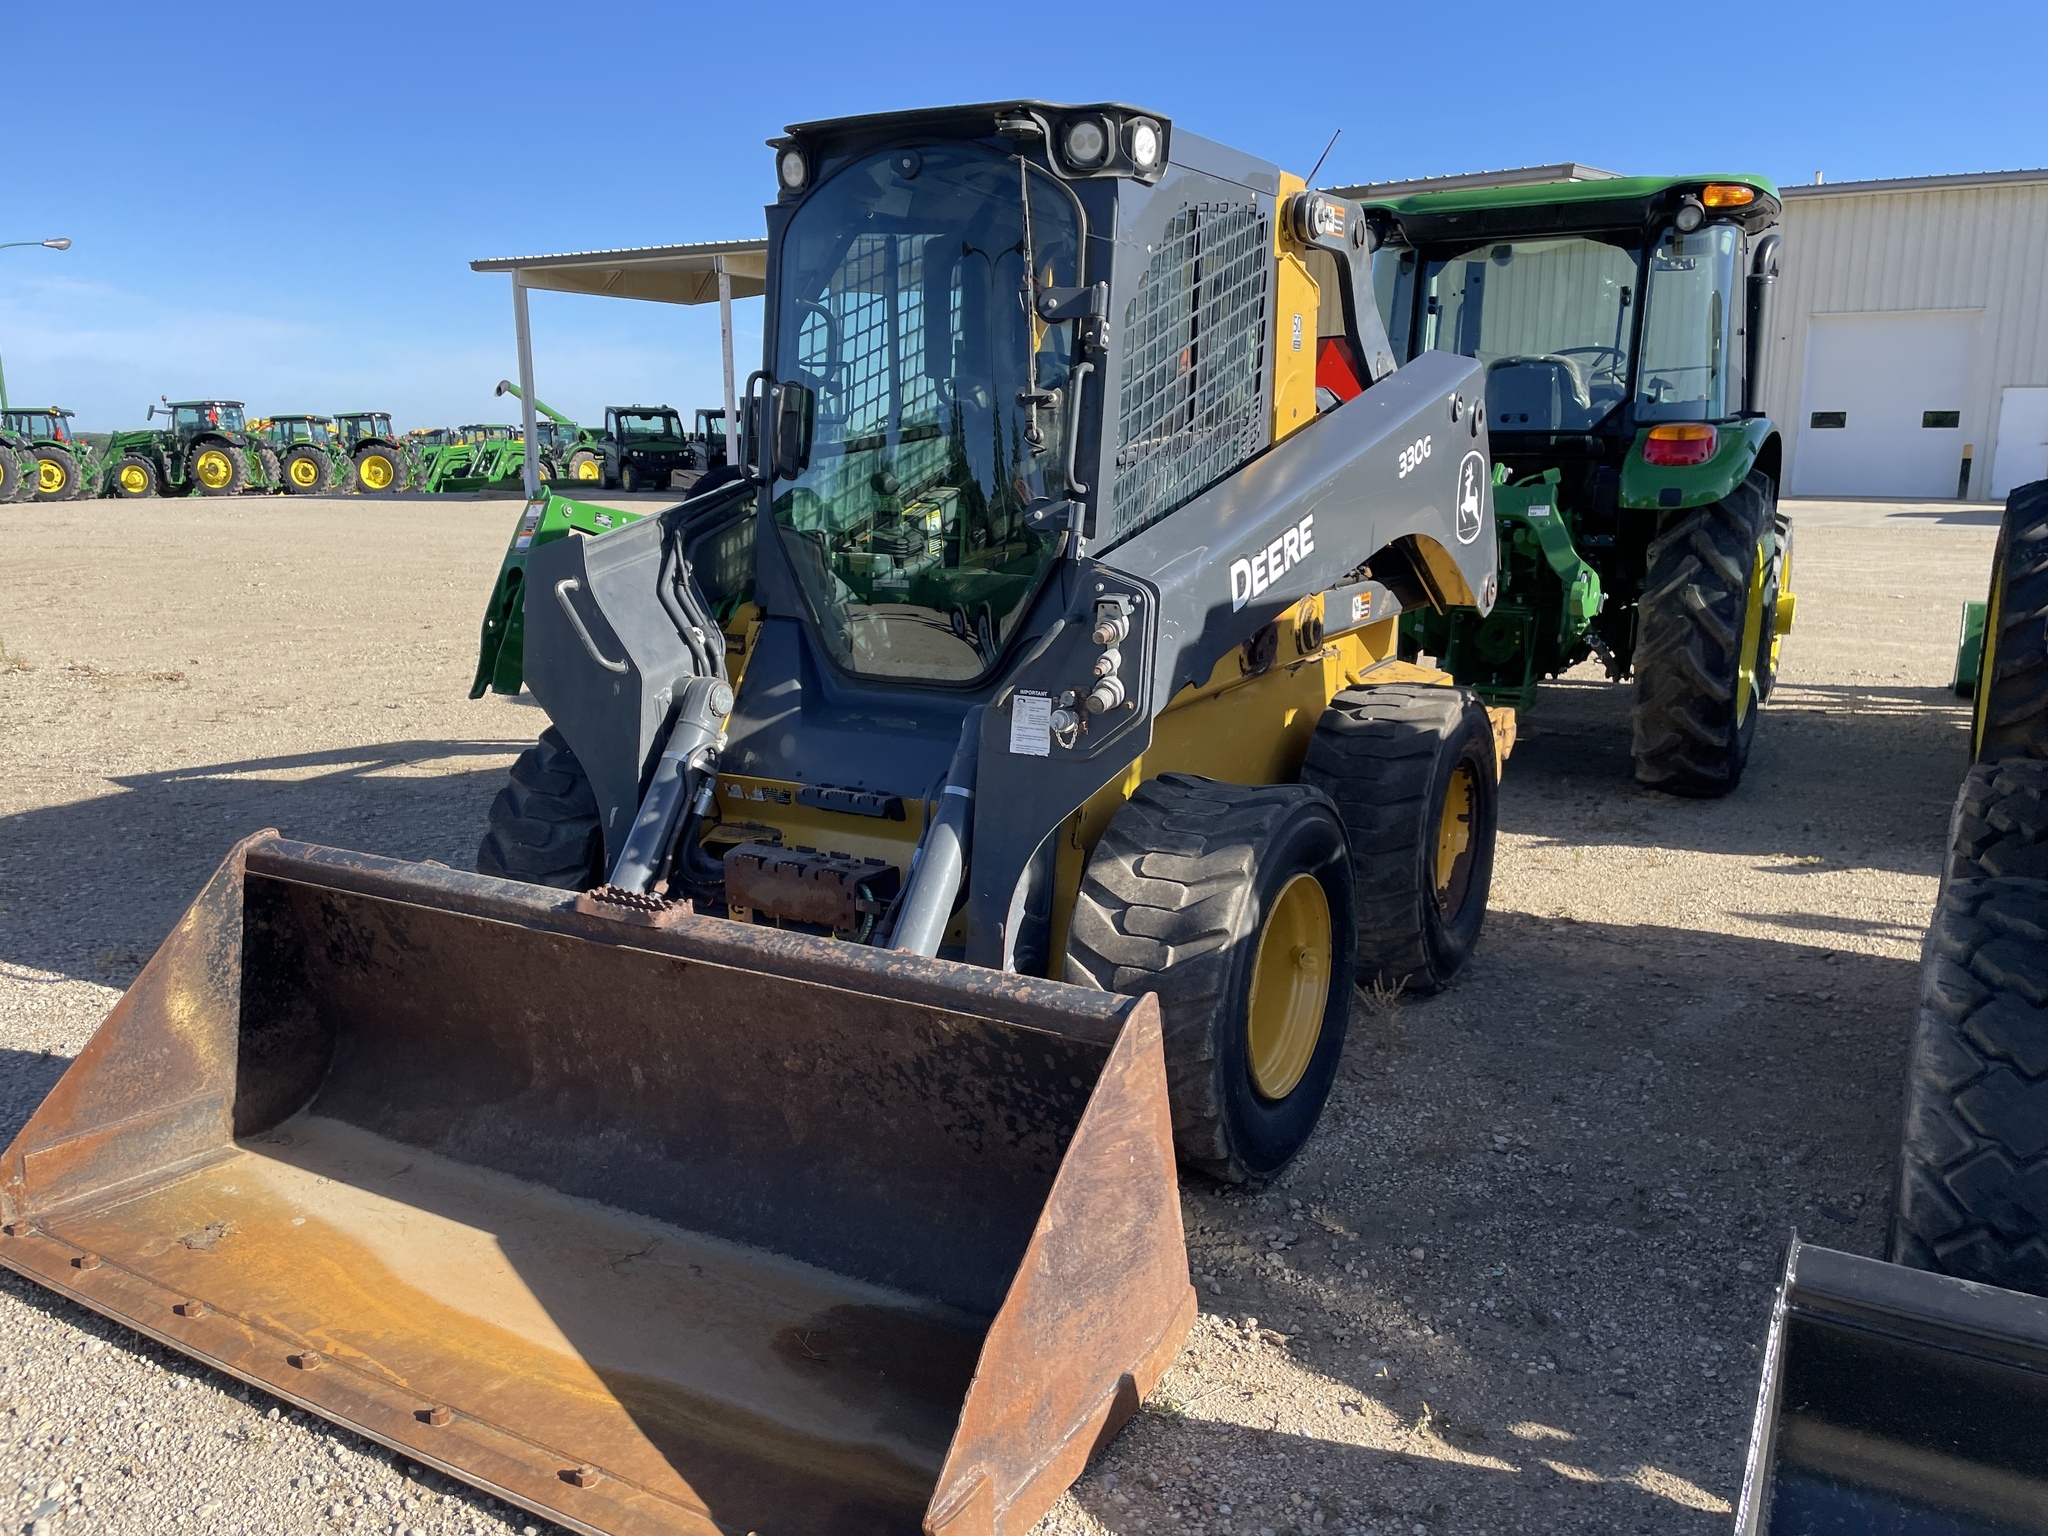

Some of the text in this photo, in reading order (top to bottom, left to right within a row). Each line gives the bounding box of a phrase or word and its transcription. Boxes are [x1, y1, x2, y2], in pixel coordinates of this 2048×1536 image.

[1398, 434, 1431, 479] 330G
[1230, 513, 1314, 613] DEERE
[1019, 689, 1049, 697] IMPORTANT
